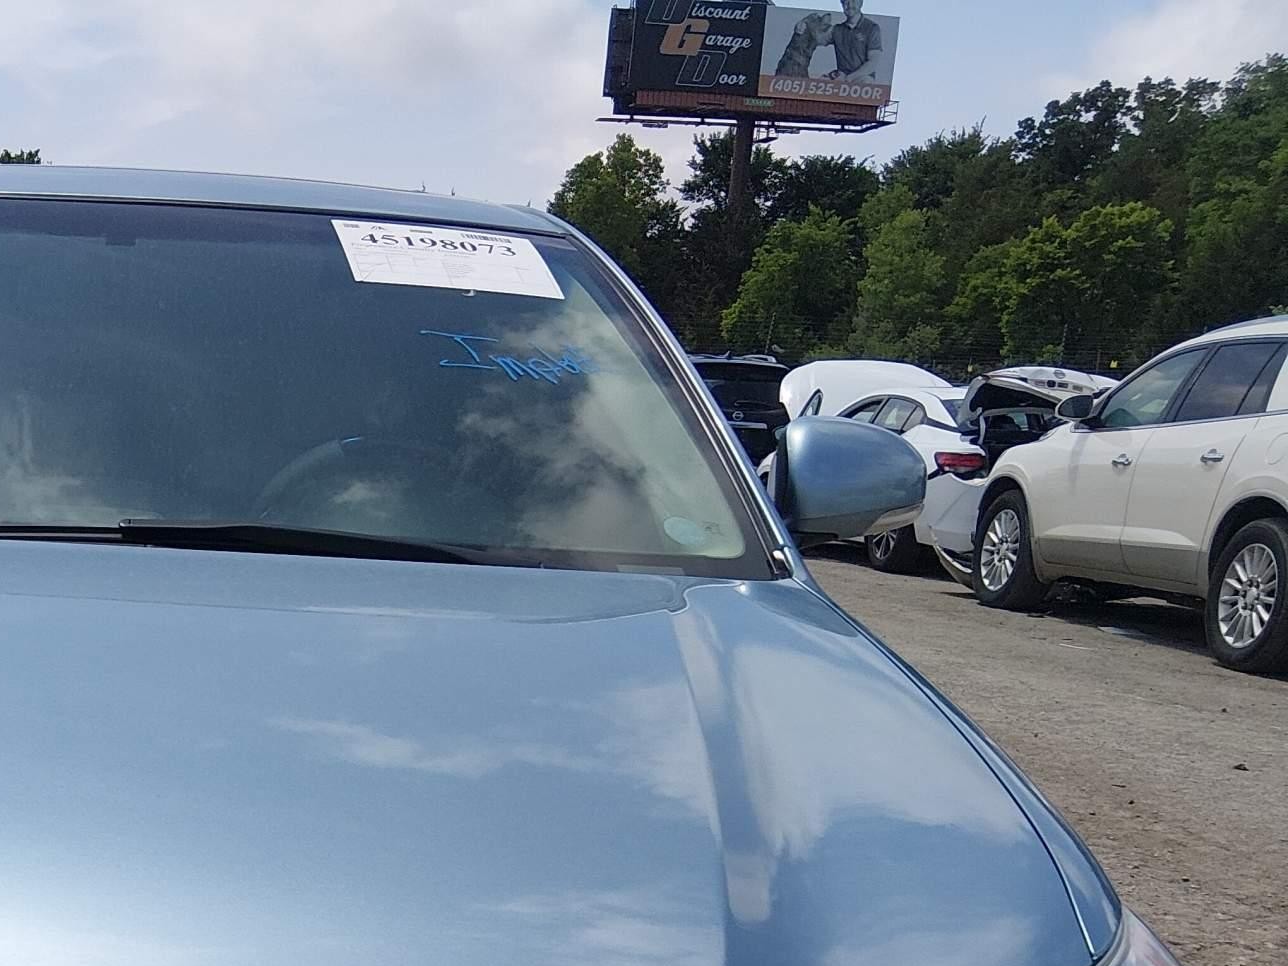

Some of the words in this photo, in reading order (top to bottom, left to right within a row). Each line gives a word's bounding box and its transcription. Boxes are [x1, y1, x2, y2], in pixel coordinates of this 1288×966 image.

[644, 0, 752, 25] Discount
[659, 18, 752, 56] Garage
[675, 49, 747, 88] Door
[769, 78, 806, 95] (405)
[808, 82, 883, 100] 525-DOOR
[360, 232, 517, 258] 45198073
